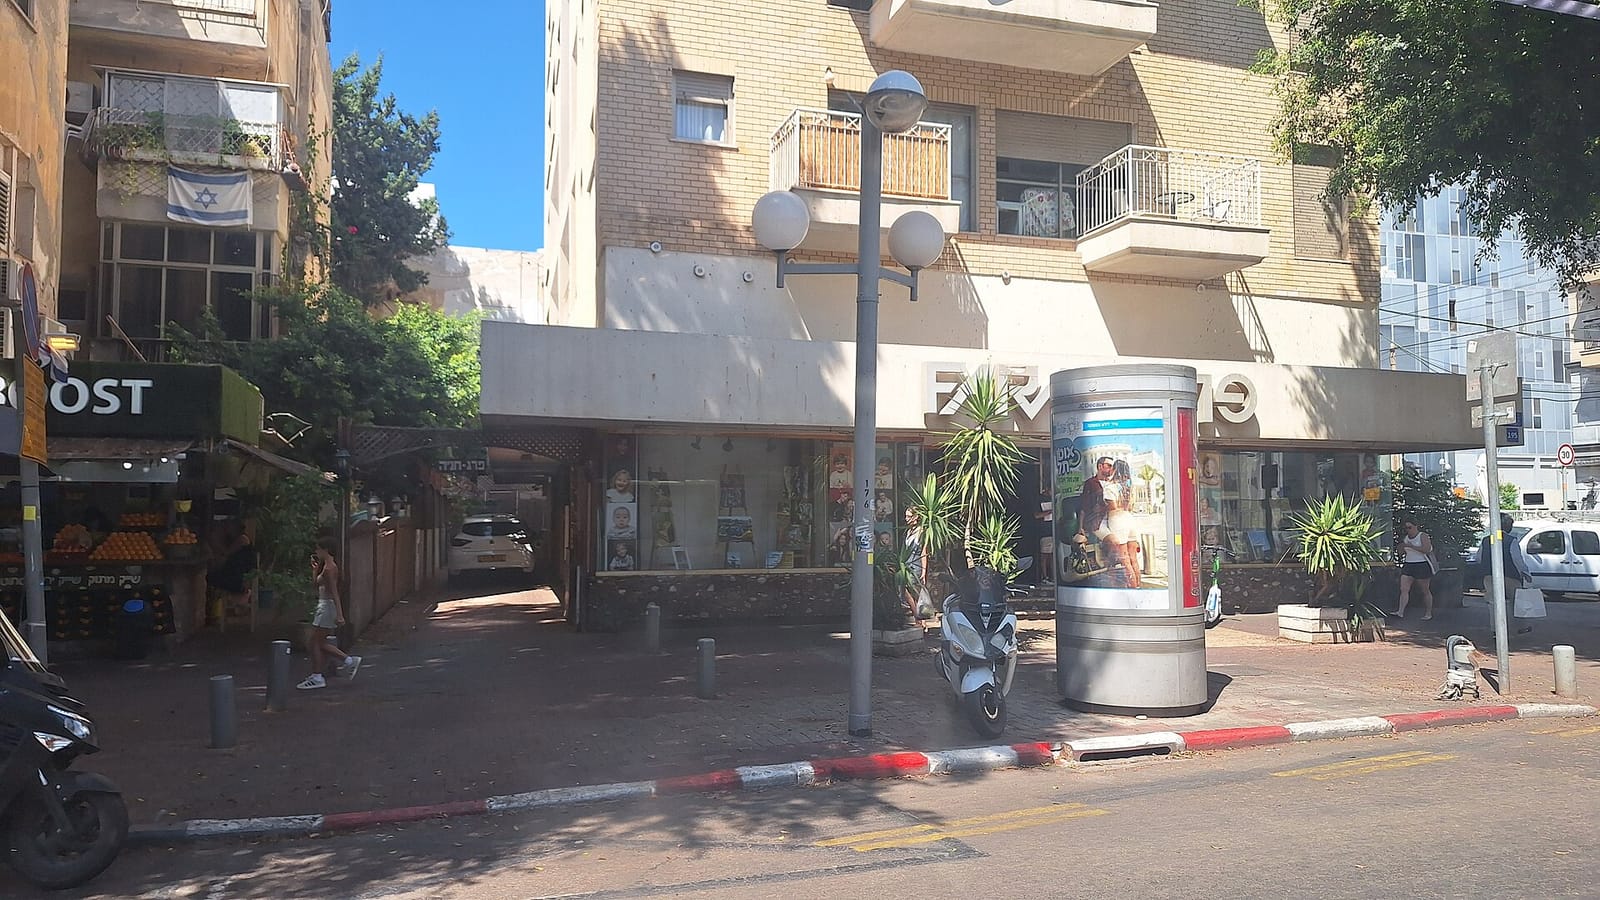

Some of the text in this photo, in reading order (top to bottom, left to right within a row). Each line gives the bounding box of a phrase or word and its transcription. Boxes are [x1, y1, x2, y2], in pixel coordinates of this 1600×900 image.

[0, 376, 154, 416] OST
[924, 360, 1051, 421] FAR
[1561, 451, 1570, 459] 30
[88, 575, 116, 587] מתוק
